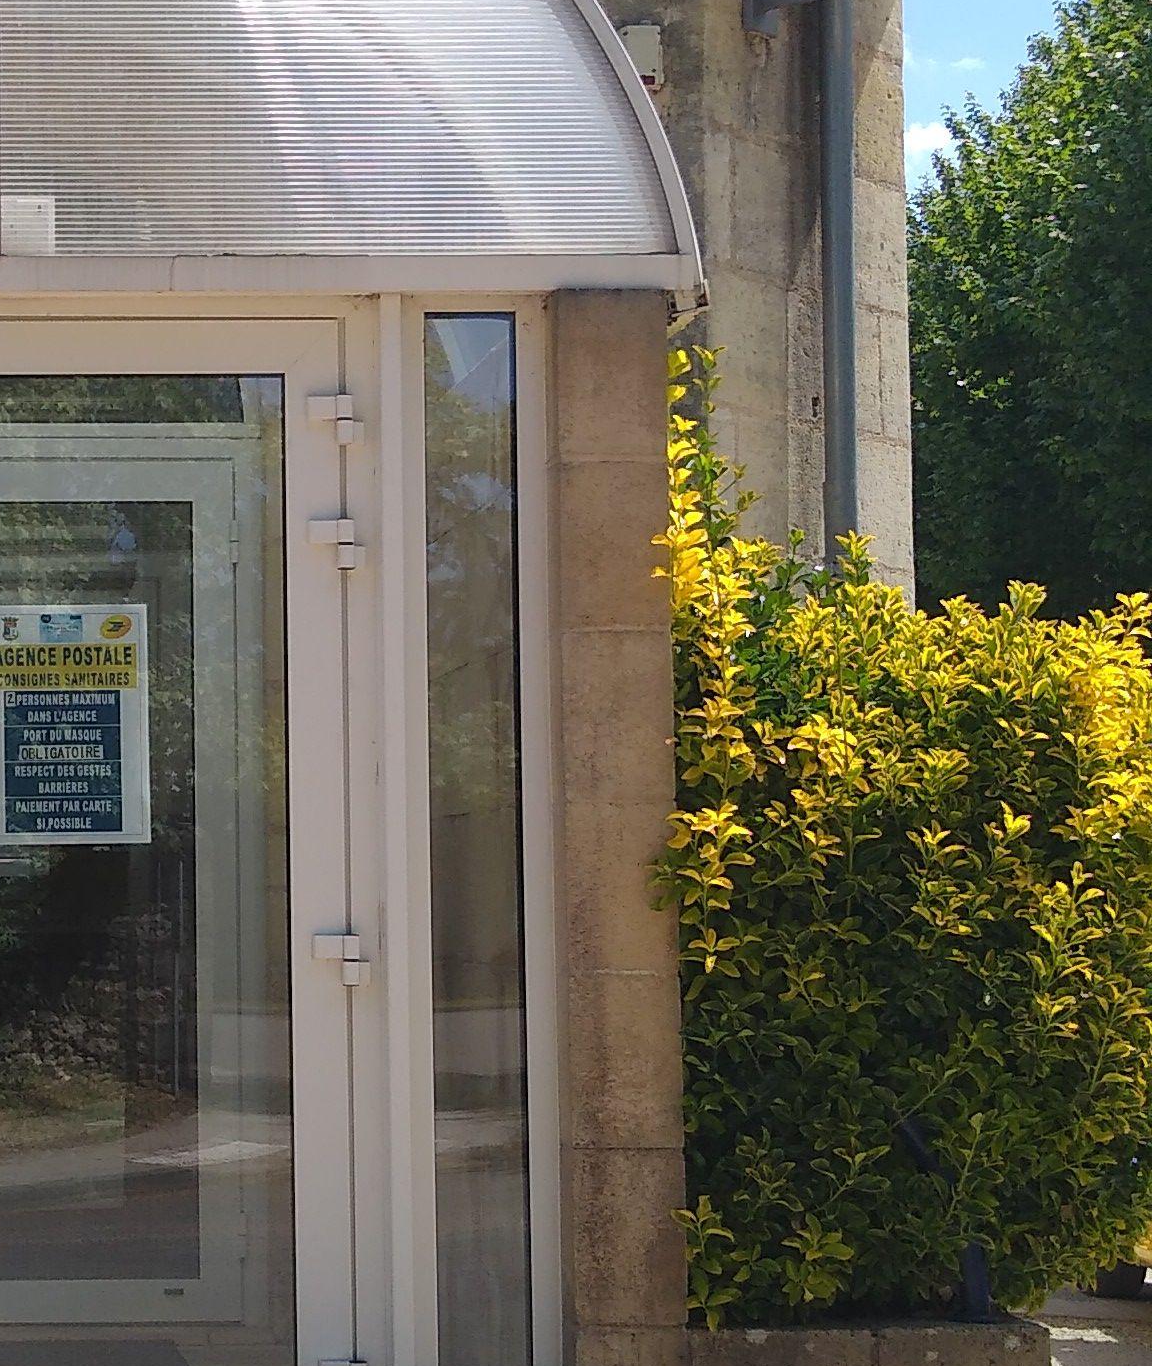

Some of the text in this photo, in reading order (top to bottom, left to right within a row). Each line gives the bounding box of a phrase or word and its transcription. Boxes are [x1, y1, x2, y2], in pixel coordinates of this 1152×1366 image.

[62, 646, 132, 666] POSTALE
[64, 671, 130, 686] SANITAIRES
[16, 693, 70, 706] PERSONNES
[72, 693, 116, 705] MAXIMUM
[27, 710, 97, 723] DANS L'AGENCE
[23, 729, 102, 742] PORT DU MASQUE
[21, 745, 101, 760] OBLIGATOIRE
[14, 764, 112, 777] RESPECT DES GESTES
[38, 780, 89, 794] BARRIÈRES
[15, 799, 112, 813] PAIEMENT PAR CARTE
[36, 817, 92, 830] SI POSSIBLE
